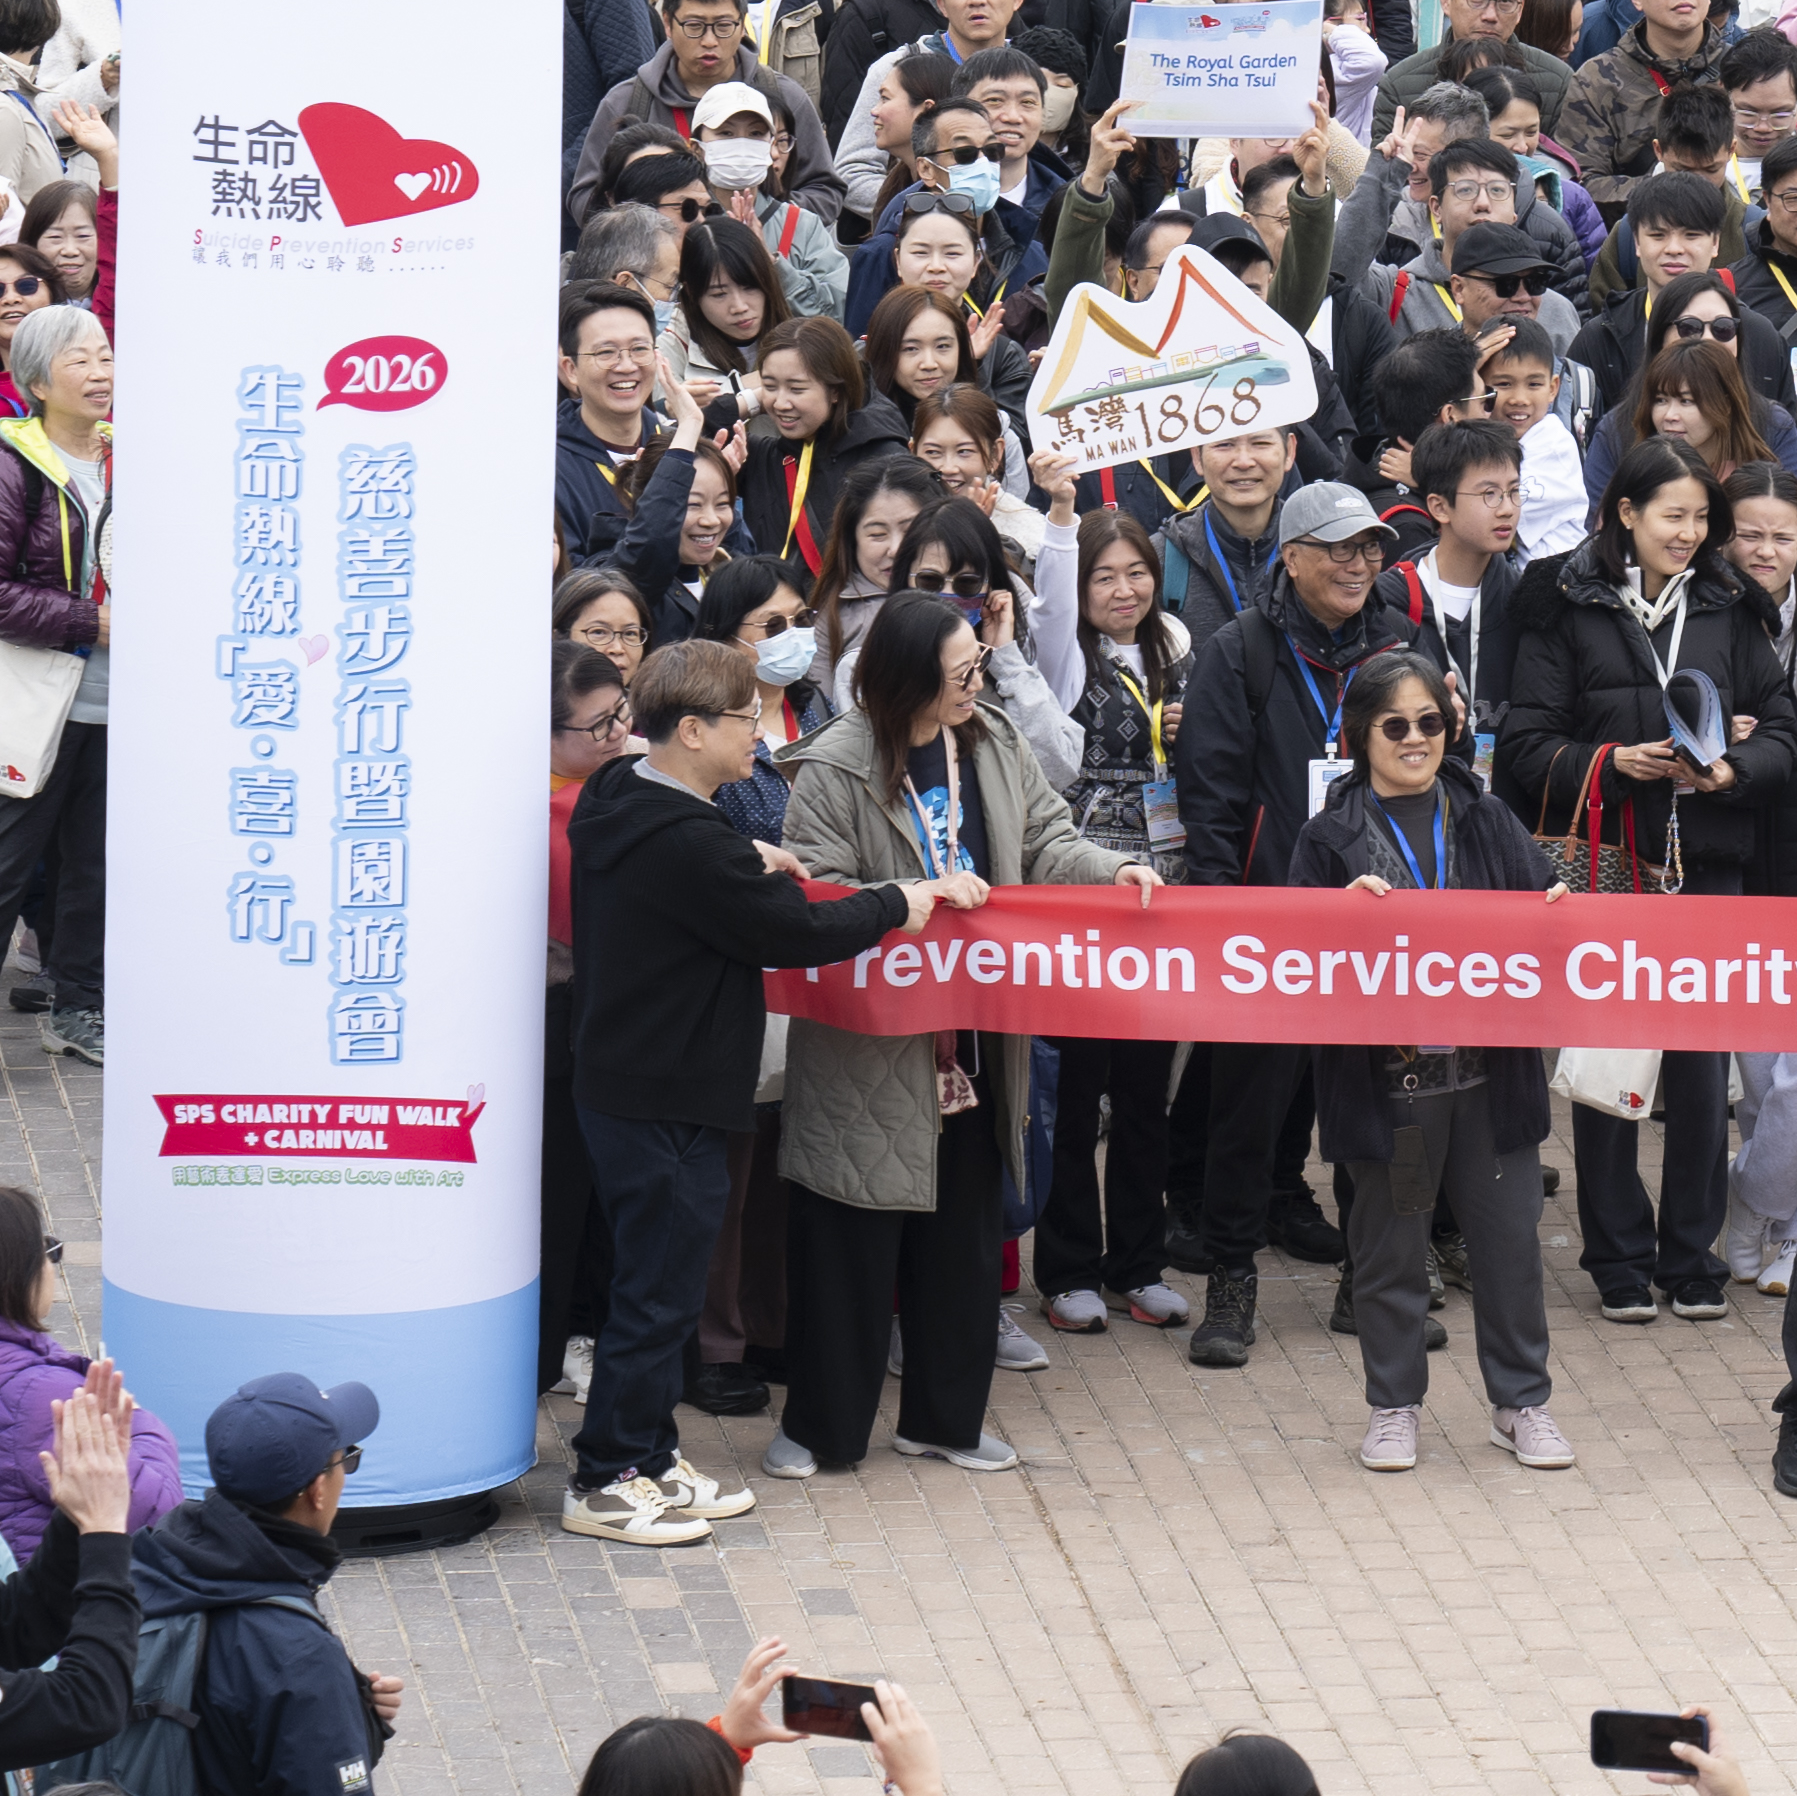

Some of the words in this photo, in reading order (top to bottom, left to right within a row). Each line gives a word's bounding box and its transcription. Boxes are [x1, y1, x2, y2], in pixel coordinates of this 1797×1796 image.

[1150, 52, 1182, 70] The
[1187, 52, 1230, 74] Royal
[1234, 52, 1297, 70] Garden
[1164, 71, 1202, 88] Tsim
[1207, 71, 1241, 88] Sha
[1244, 71, 1277, 88] Tsui
[192, 114, 300, 170] 生命
[210, 170, 324, 224] 熱線
[193, 228, 264, 252] Suicide
[269, 235, 386, 256] Prevention
[392, 233, 475, 256] Services
[340, 352, 437, 395] 2026
[1048, 394, 1131, 452] 馬灣
[1135, 373, 1262, 449] 1868
[1085, 445, 1105, 462] MA
[1108, 437, 1137, 456] WAN
[333, 446, 415, 1063] 慈善步行暨園遊會
[806, 929, 1196, 992] revention
[1220, 933, 1541, 998] Services
[174, 1104, 214, 1125] SPS
[220, 1103, 333, 1126] CHARITY
[339, 1105, 389, 1126] FUN
[396, 1105, 461, 1128] WALK
[244, 1132, 259, 1148] +
[264, 1130, 389, 1151] CARNIVAL
[267, 1166, 342, 1187] Express
[345, 1166, 393, 1187] Love
[395, 1166, 434, 1187] with
[437, 1168, 464, 1187] Art
[339, 1759, 368, 1784] HH
